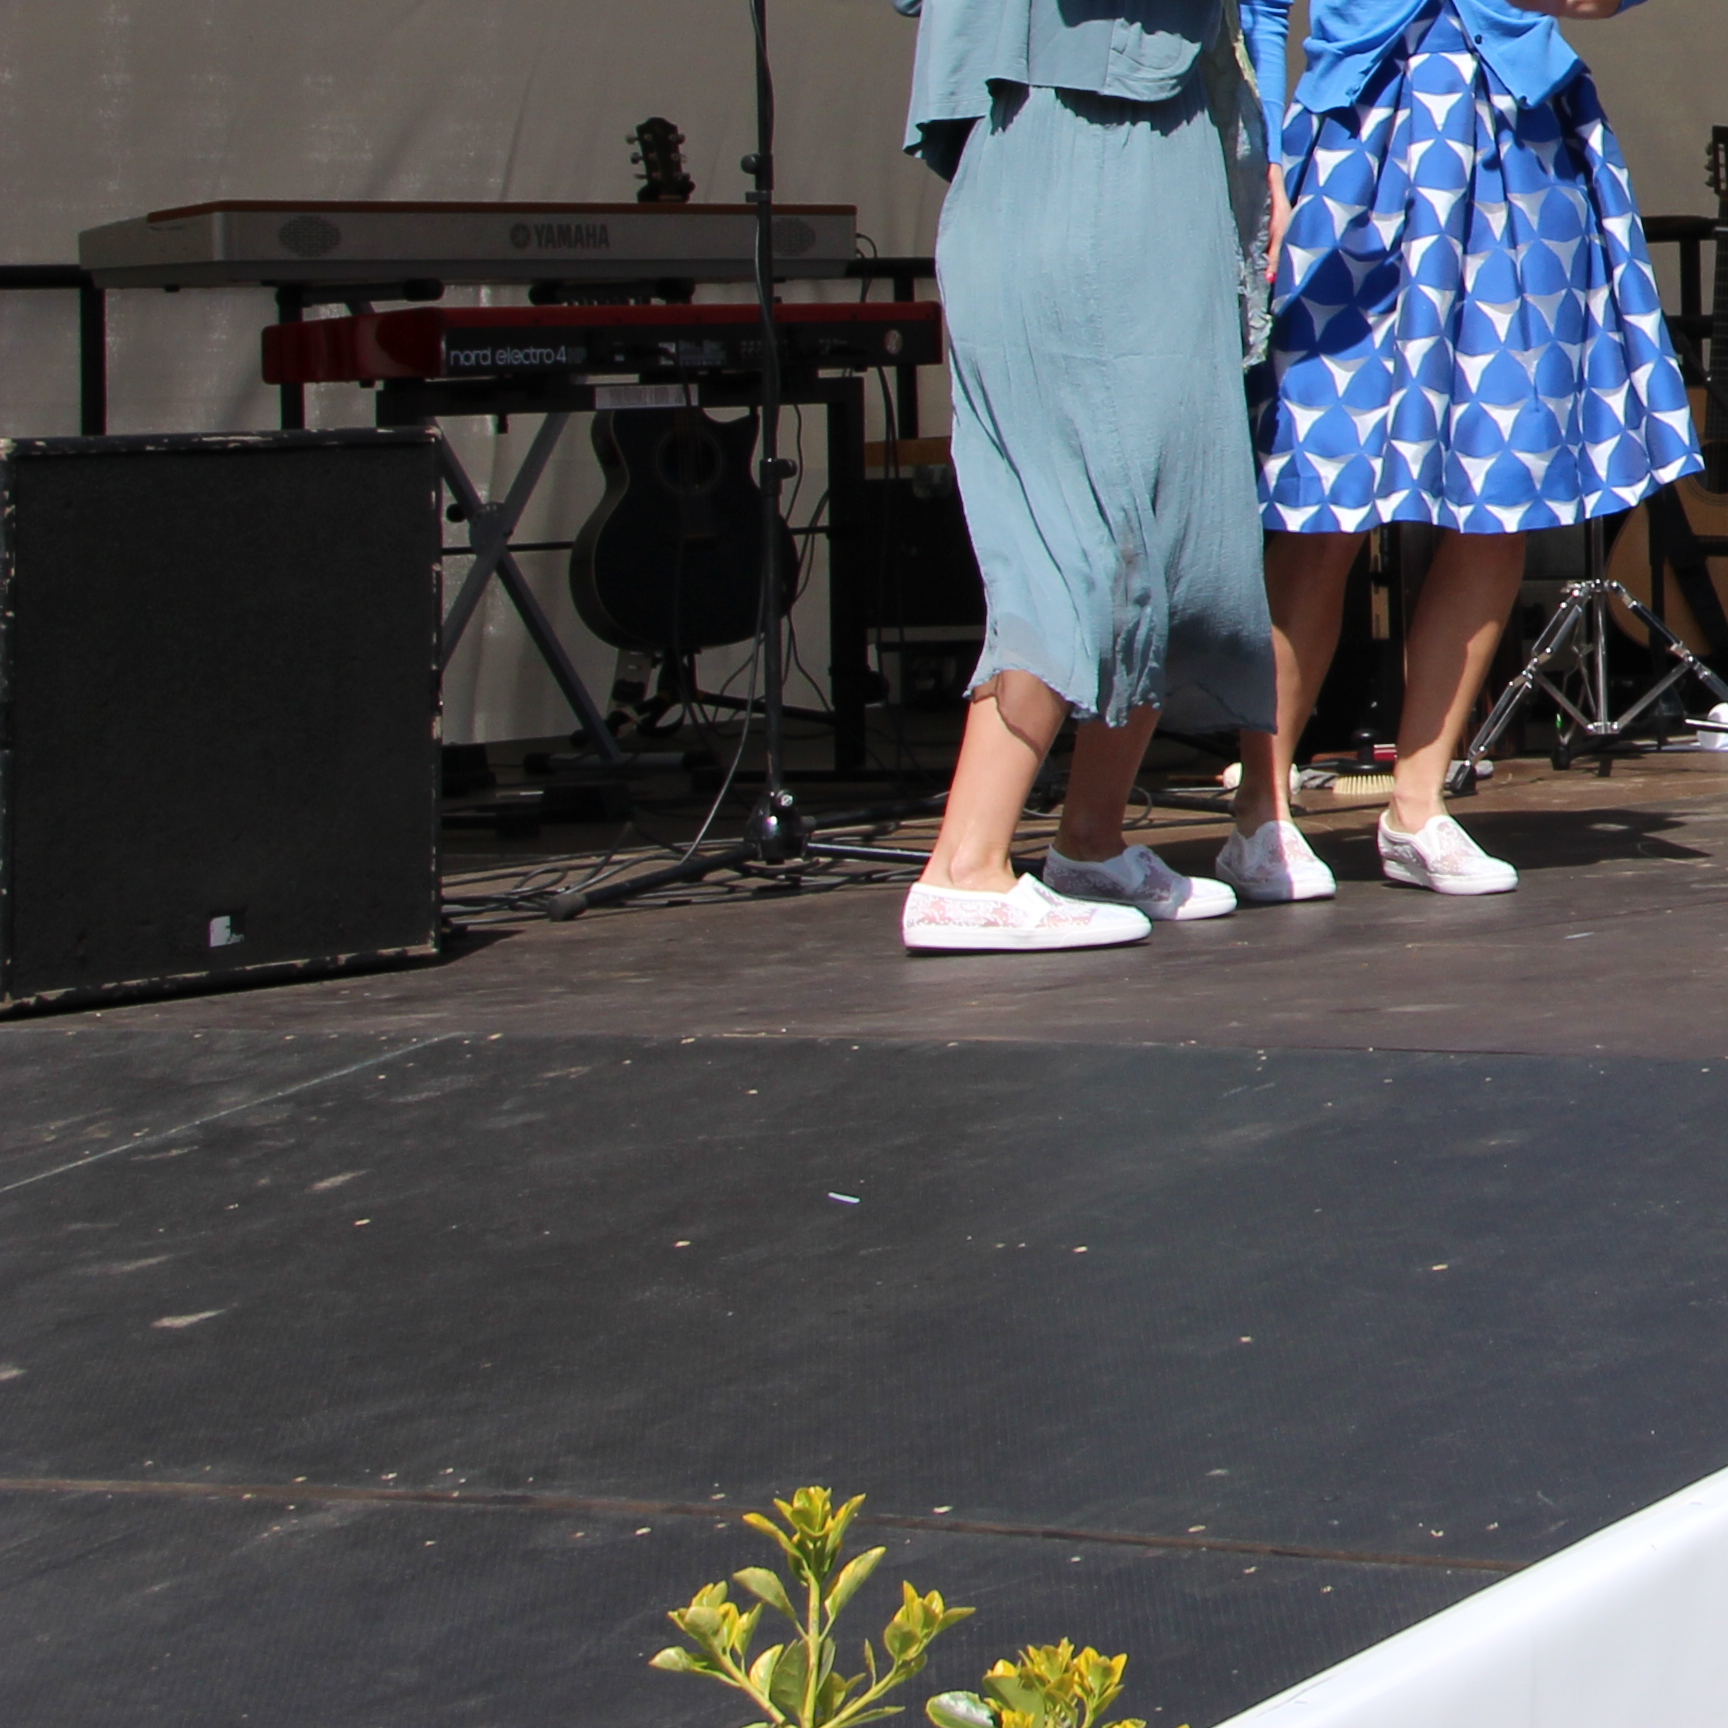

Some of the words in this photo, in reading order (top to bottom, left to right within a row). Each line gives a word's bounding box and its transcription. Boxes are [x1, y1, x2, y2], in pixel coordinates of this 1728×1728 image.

[533, 223, 610, 249] YAMAHA
[450, 346, 491, 366] nord
[495, 346, 555, 365] electro
